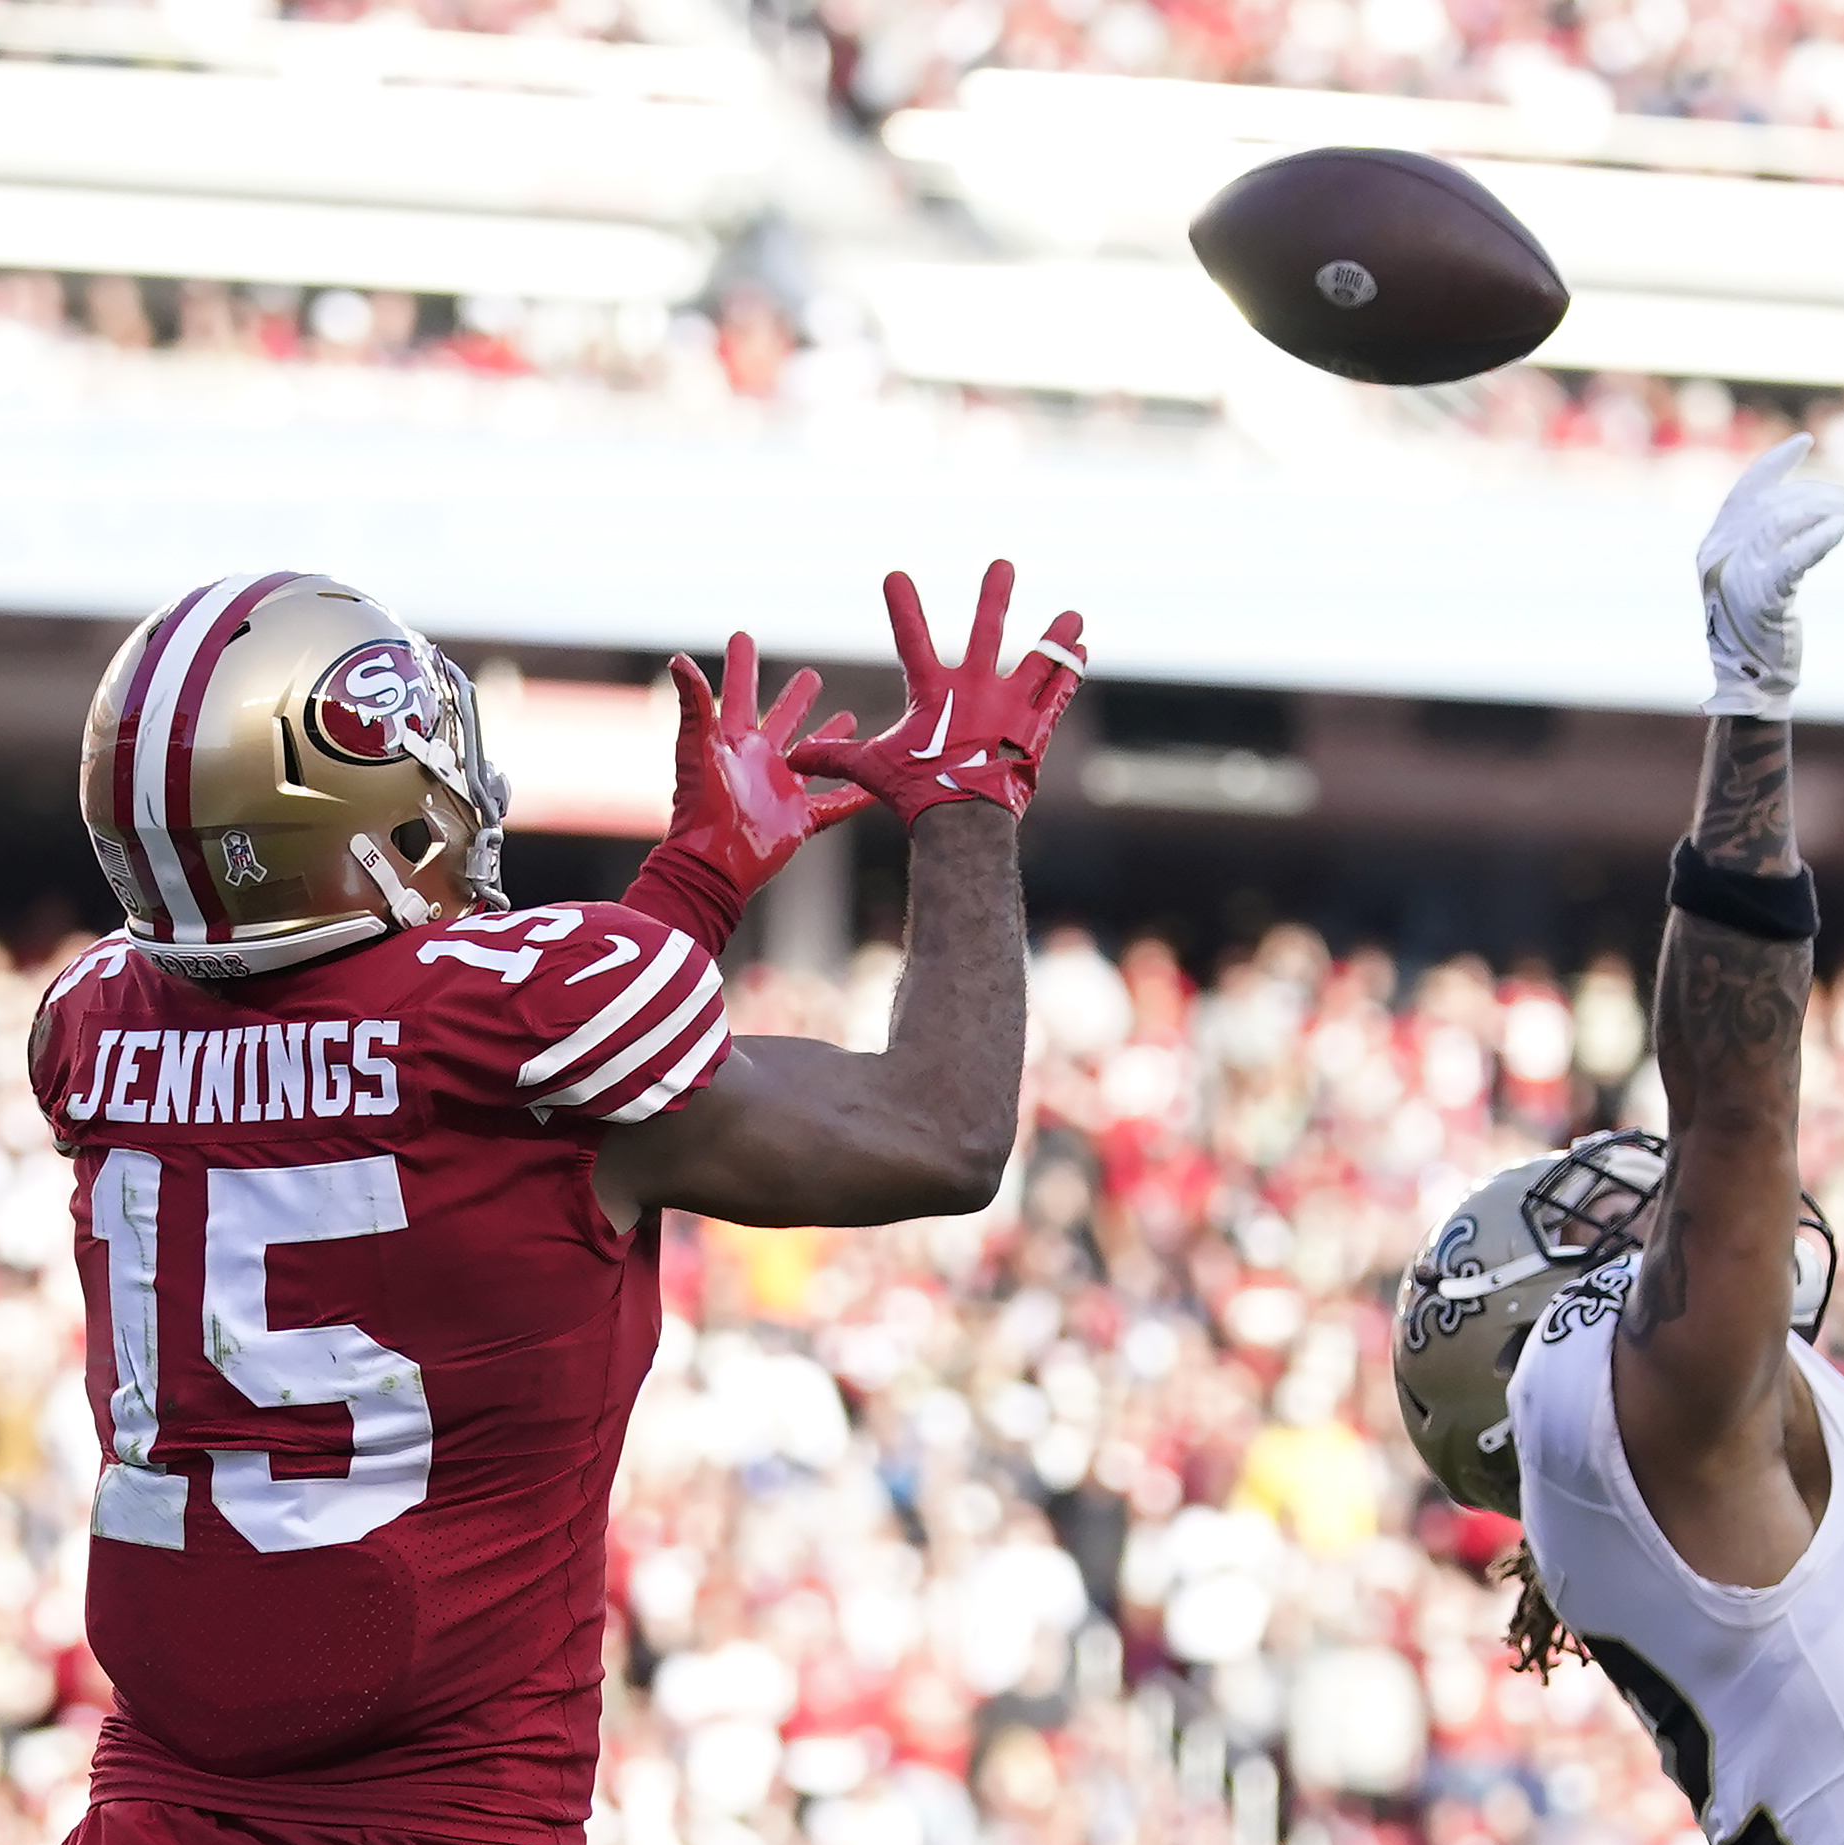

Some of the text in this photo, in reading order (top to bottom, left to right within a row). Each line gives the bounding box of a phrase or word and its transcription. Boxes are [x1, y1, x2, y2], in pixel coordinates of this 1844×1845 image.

[230, 853, 252, 869] NFL
[362, 849, 379, 868] 15
[415, 907, 585, 984] 15
[66, 1020, 401, 1123] JENNINGS
[91, 1148, 433, 1553] 15
